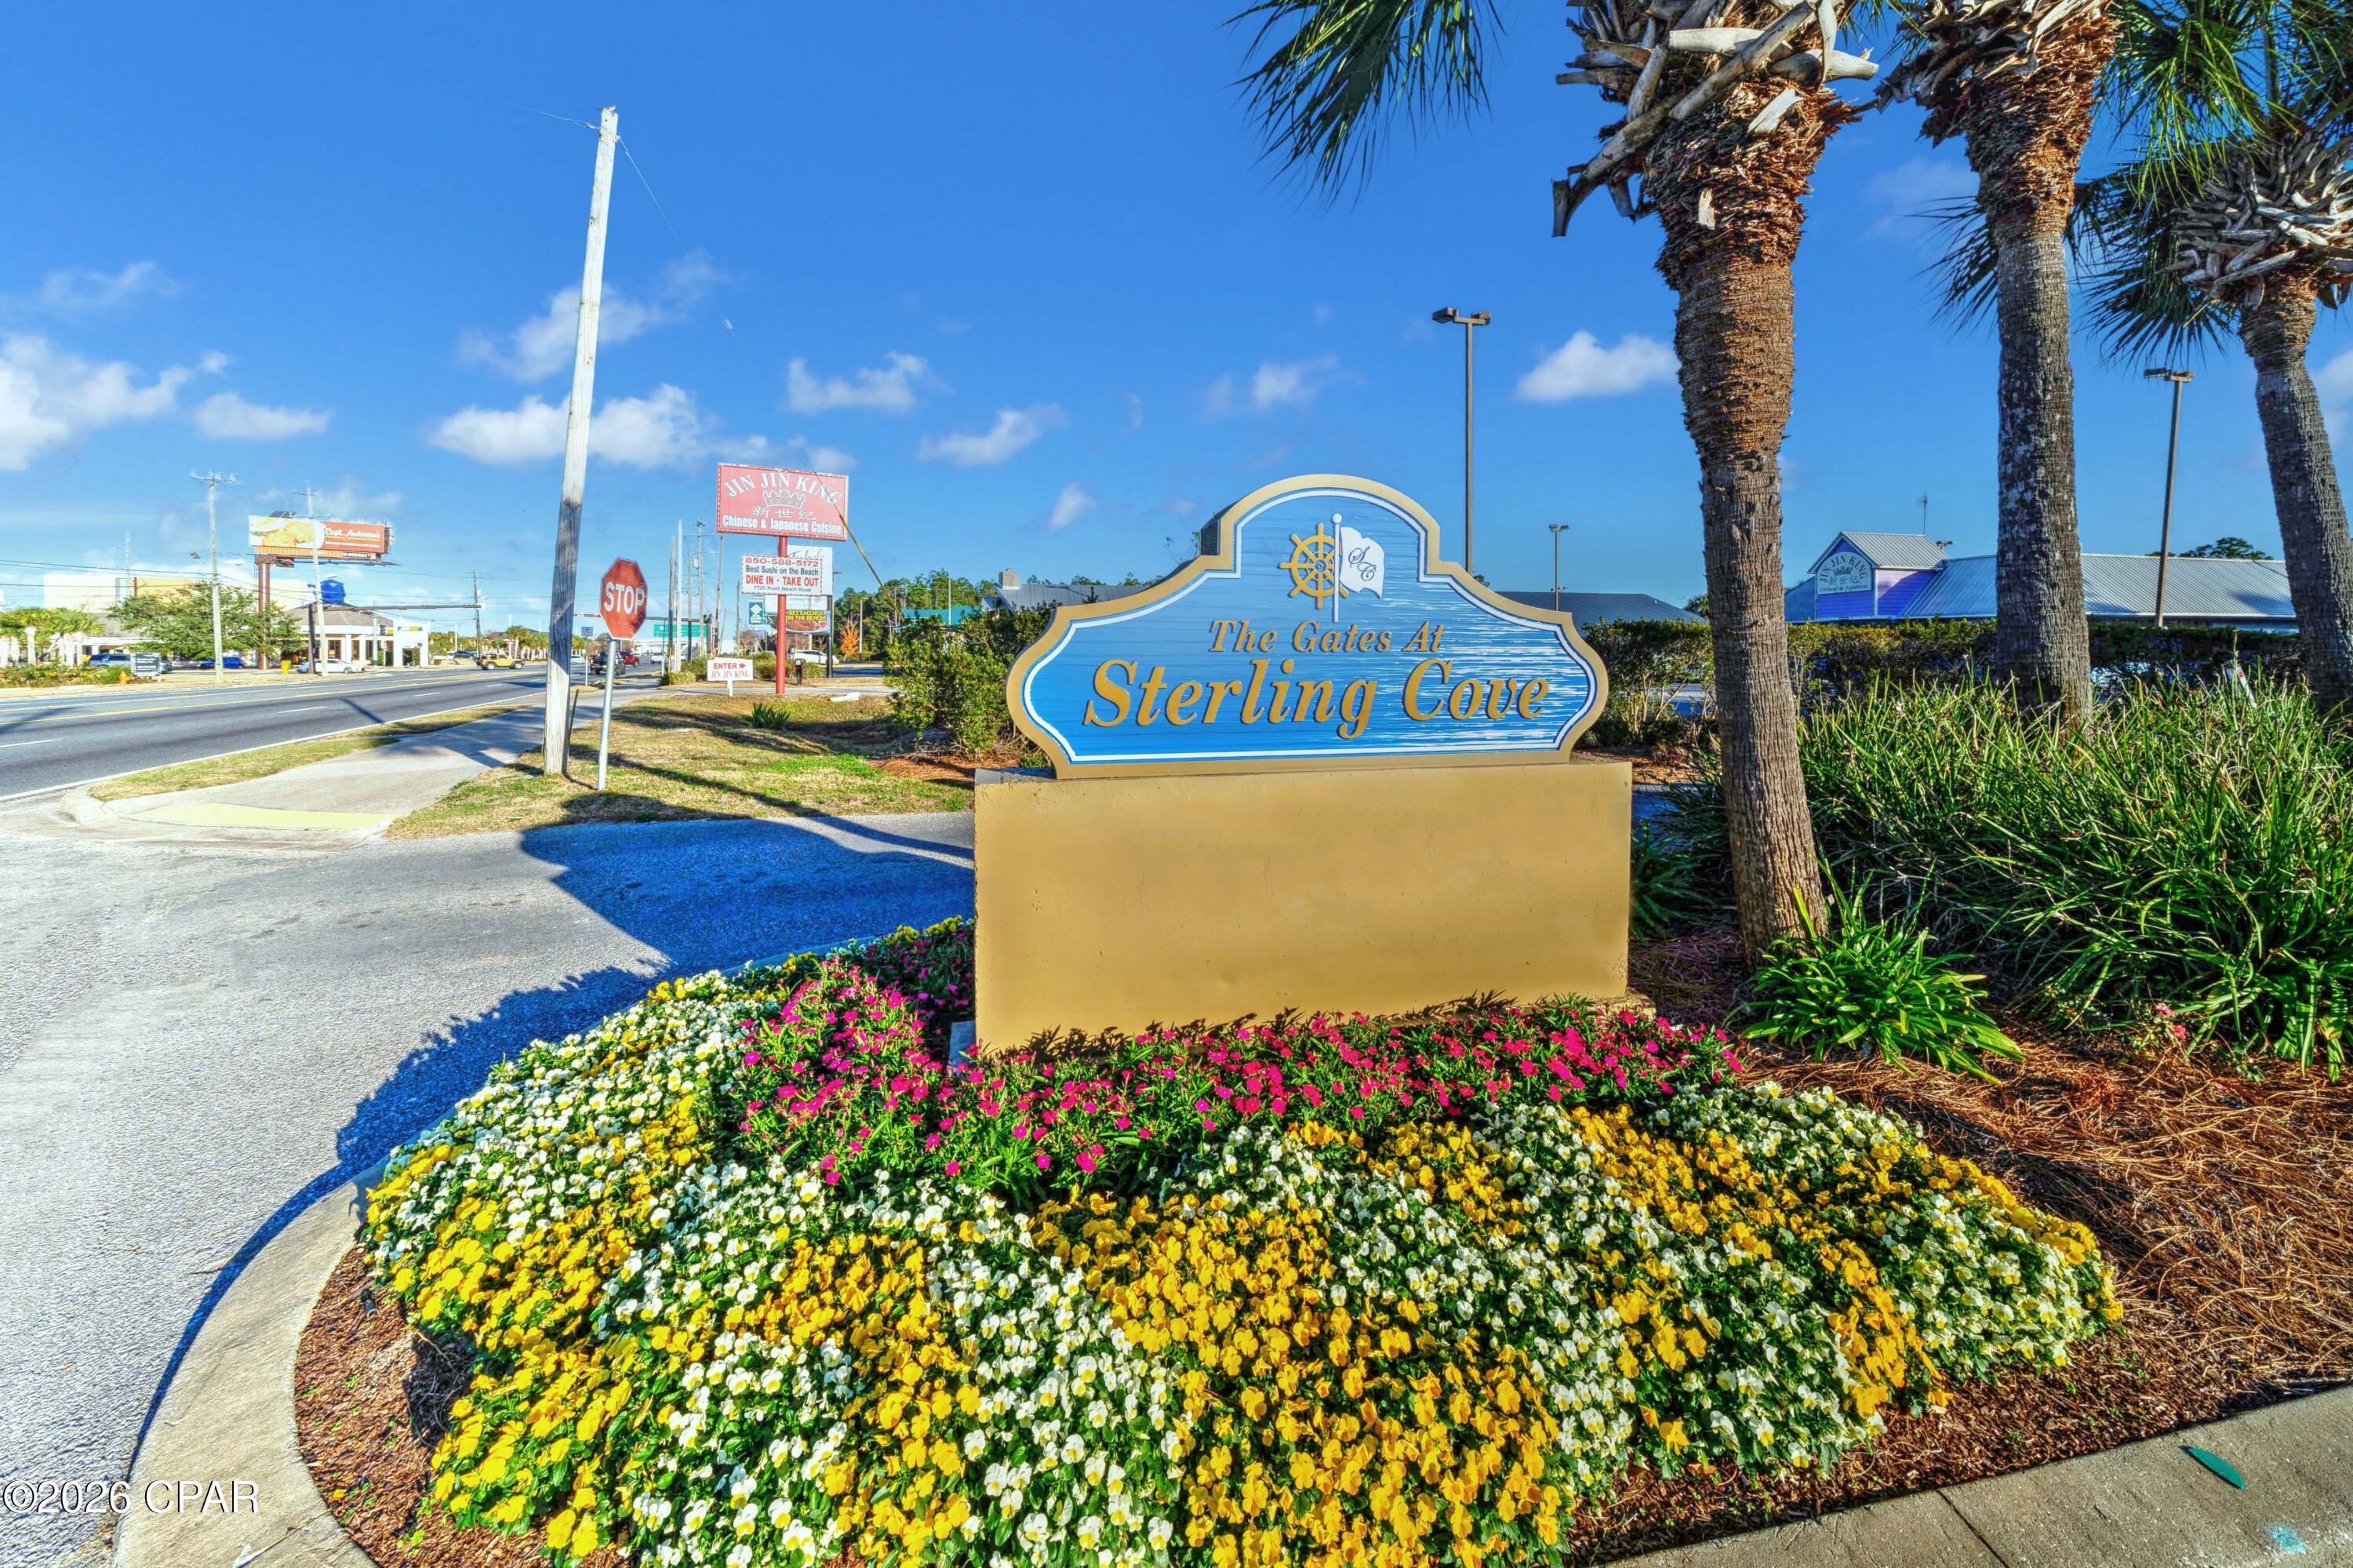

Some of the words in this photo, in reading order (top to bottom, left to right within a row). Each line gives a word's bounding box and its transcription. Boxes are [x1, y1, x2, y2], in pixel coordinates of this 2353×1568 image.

[722, 474, 756, 497] JIN
[760, 472, 791, 488] JIN
[795, 475, 842, 504] KING
[722, 514, 758, 529] Chinese
[760, 518, 767, 529] &
[770, 518, 809, 532] Japanese
[811, 521, 842, 535] Cuisine
[752, 505, 816, 520] 新世纪
[745, 557, 819, 567] 850-588-5172
[762, 566, 778, 574] Sushi
[1820, 566, 1831, 583] JIN
[1831, 555, 1846, 567] JIN
[1849, 555, 1867, 580] KING
[746, 574, 763, 584] DINE
[766, 576, 773, 584] IN
[783, 576, 802, 587] TAKE
[804, 577, 819, 587] OUT
[603, 581, 645, 615] STOP
[1209, 620, 1278, 653] The
[1292, 620, 1392, 653] Gates
[1401, 620, 1445, 653] At
[1082, 657, 1378, 740] Sterling
[1402, 657, 1549, 722] Cove
